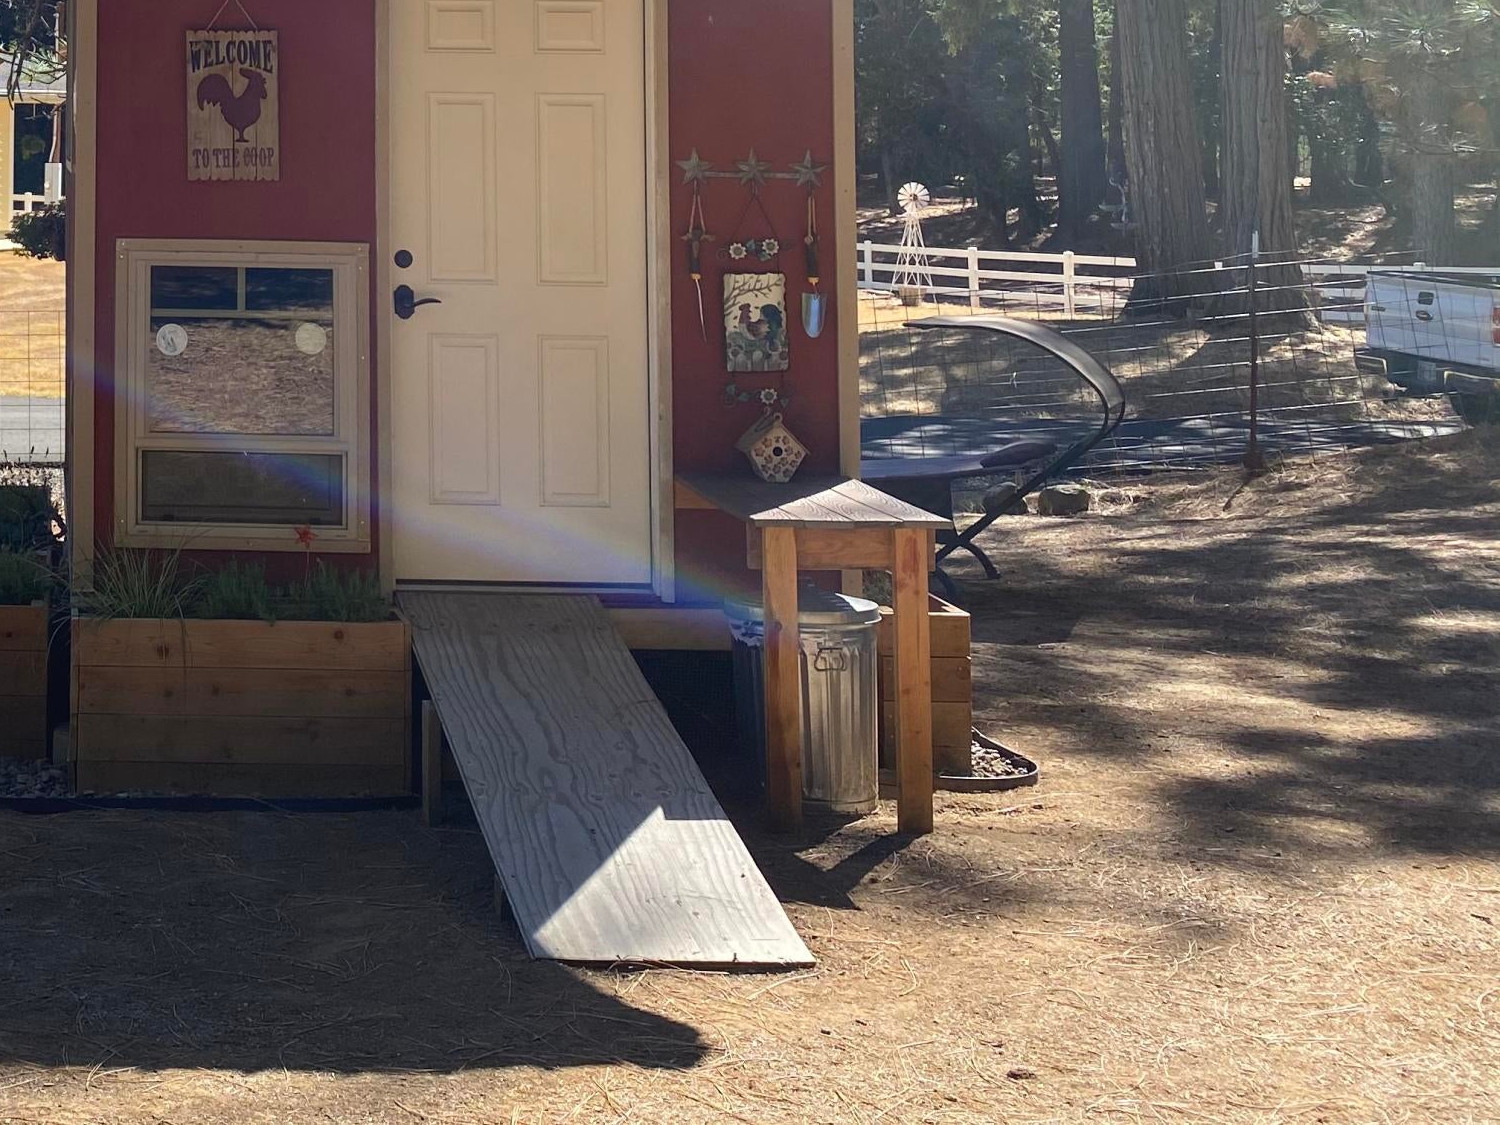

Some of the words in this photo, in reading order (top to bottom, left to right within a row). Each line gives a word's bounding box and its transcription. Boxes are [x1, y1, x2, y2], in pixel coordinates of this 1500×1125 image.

[189, 40, 273, 73] WELCOME
[192, 147, 210, 169] TO
[212, 147, 240, 169] THE
[243, 146, 275, 168] COOP
